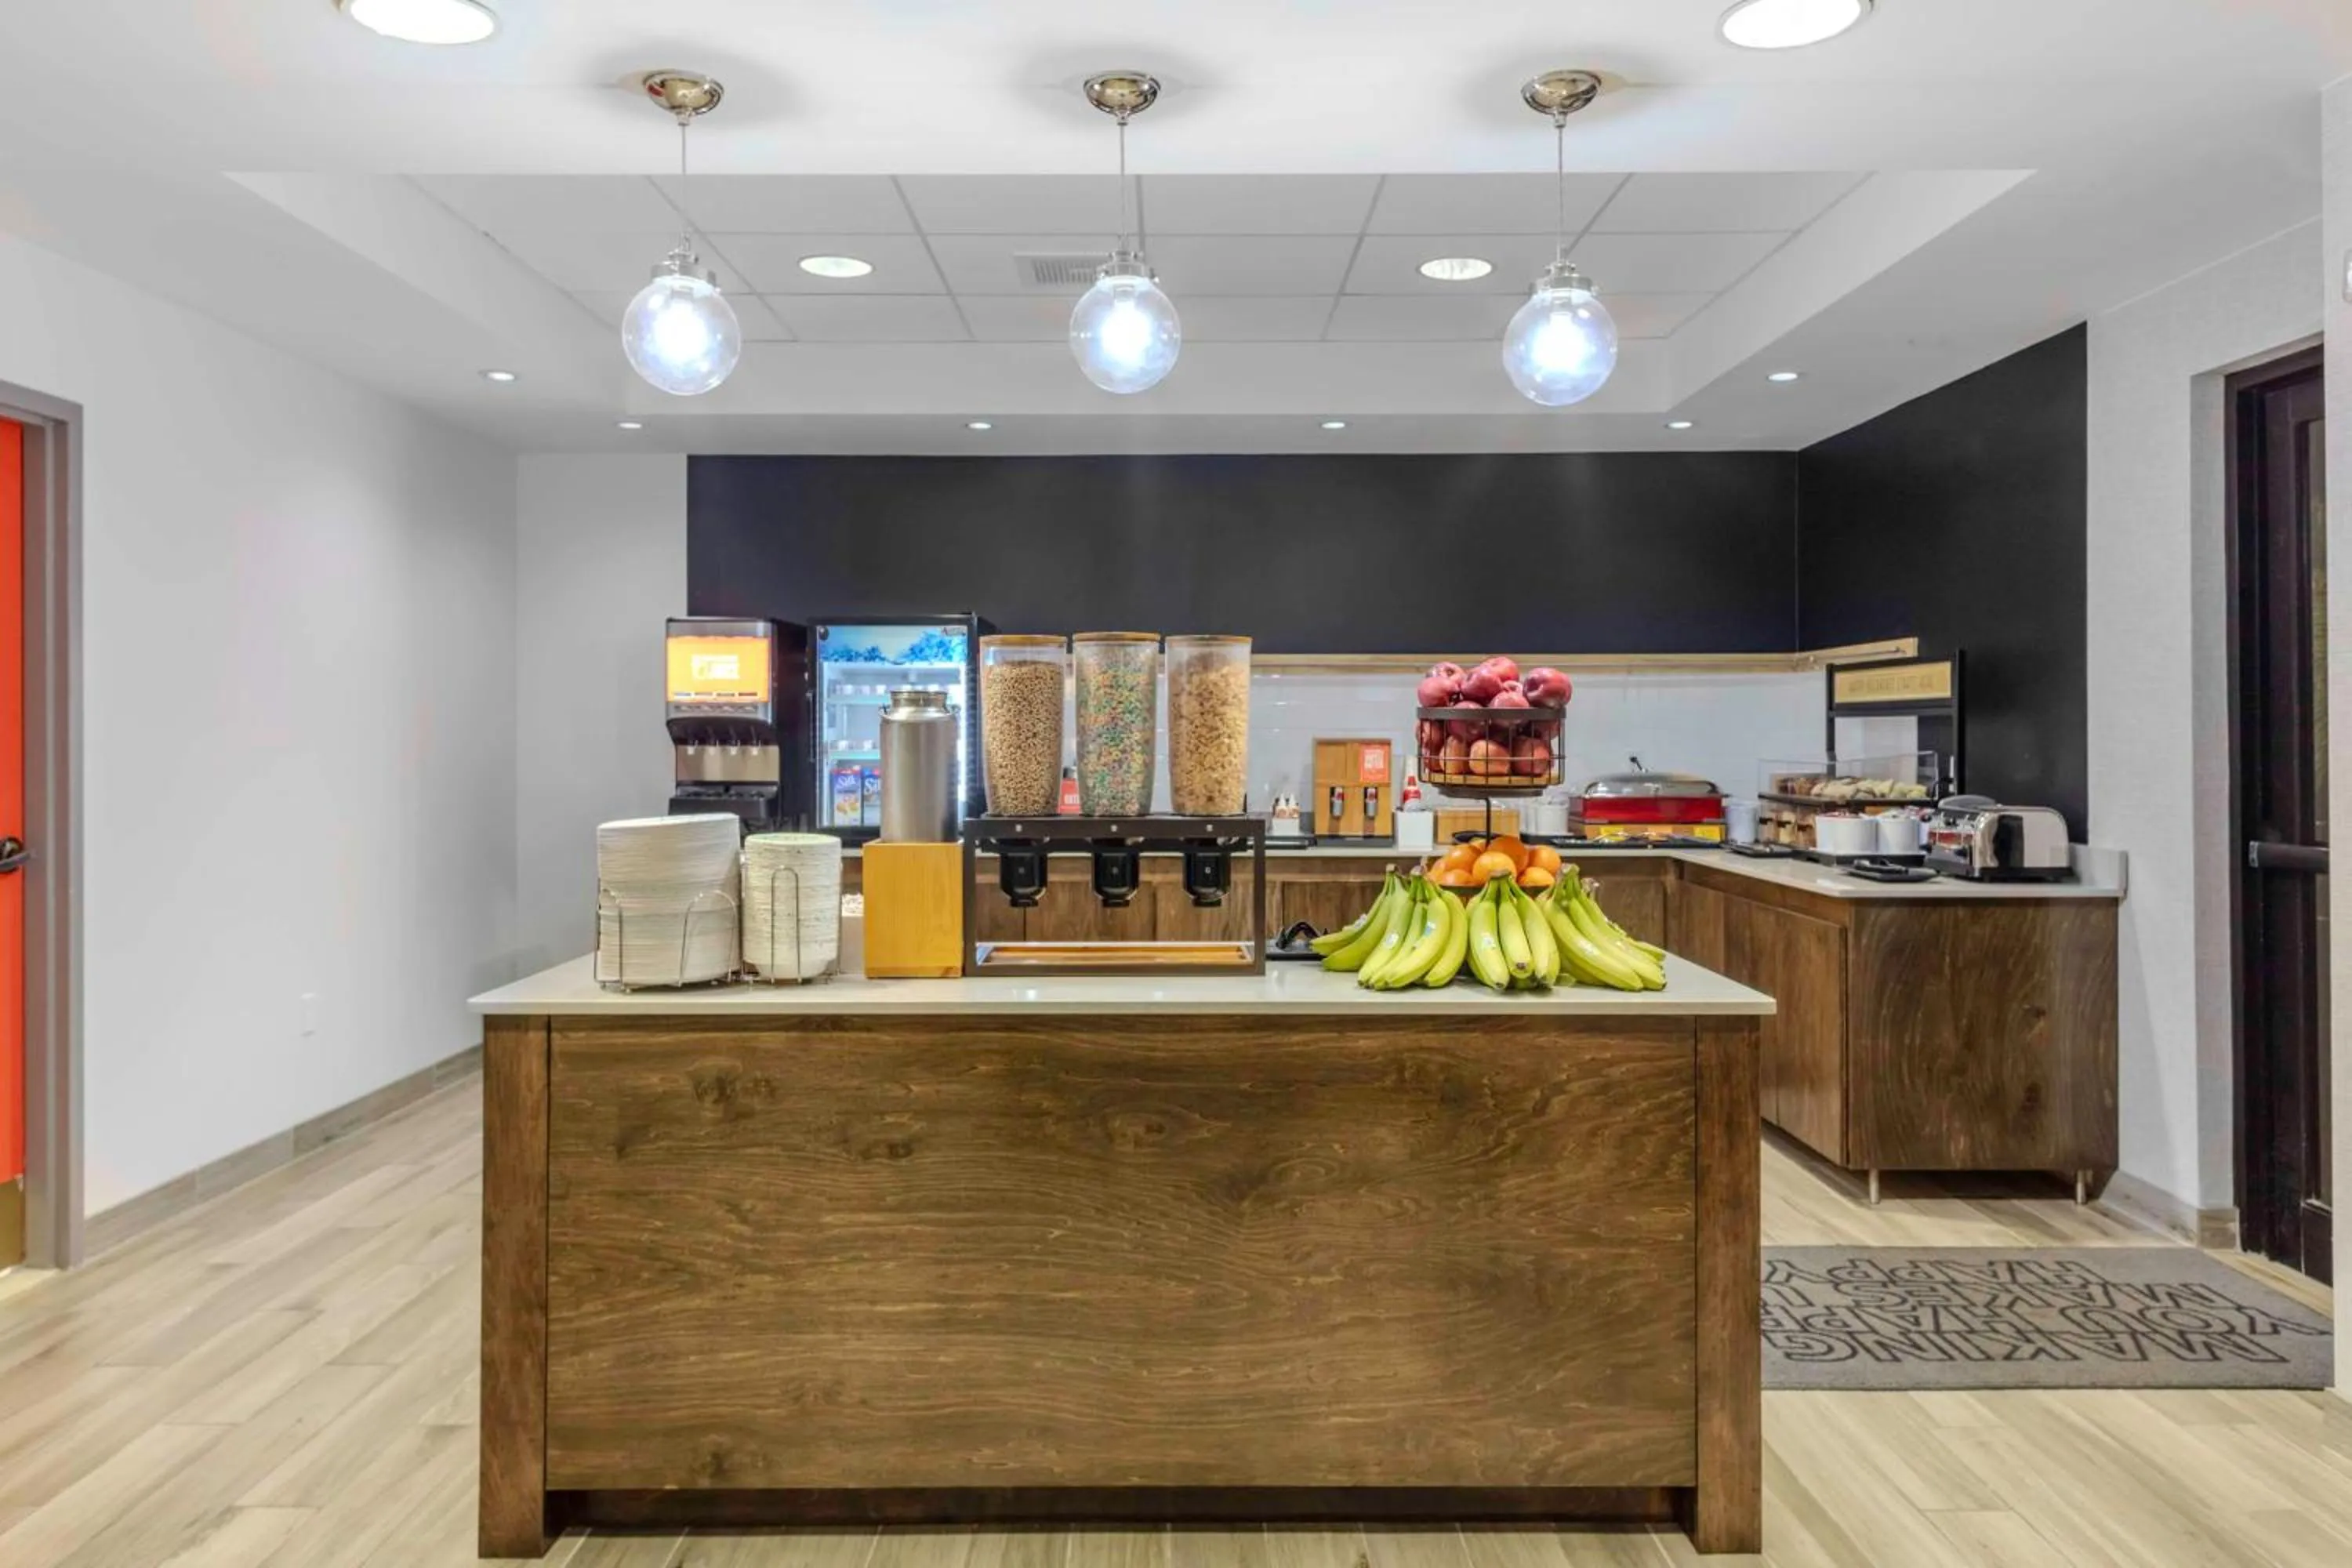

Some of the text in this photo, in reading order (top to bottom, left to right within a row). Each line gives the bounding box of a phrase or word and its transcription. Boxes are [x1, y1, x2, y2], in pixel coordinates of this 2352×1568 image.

[1765, 1258, 2112, 1287] HAPPY
[1831, 1281, 2241, 1312] MAKES
[1761, 1305, 2333, 1344] YOU HAPP
[1762, 1330, 2290, 1363] MAKING
